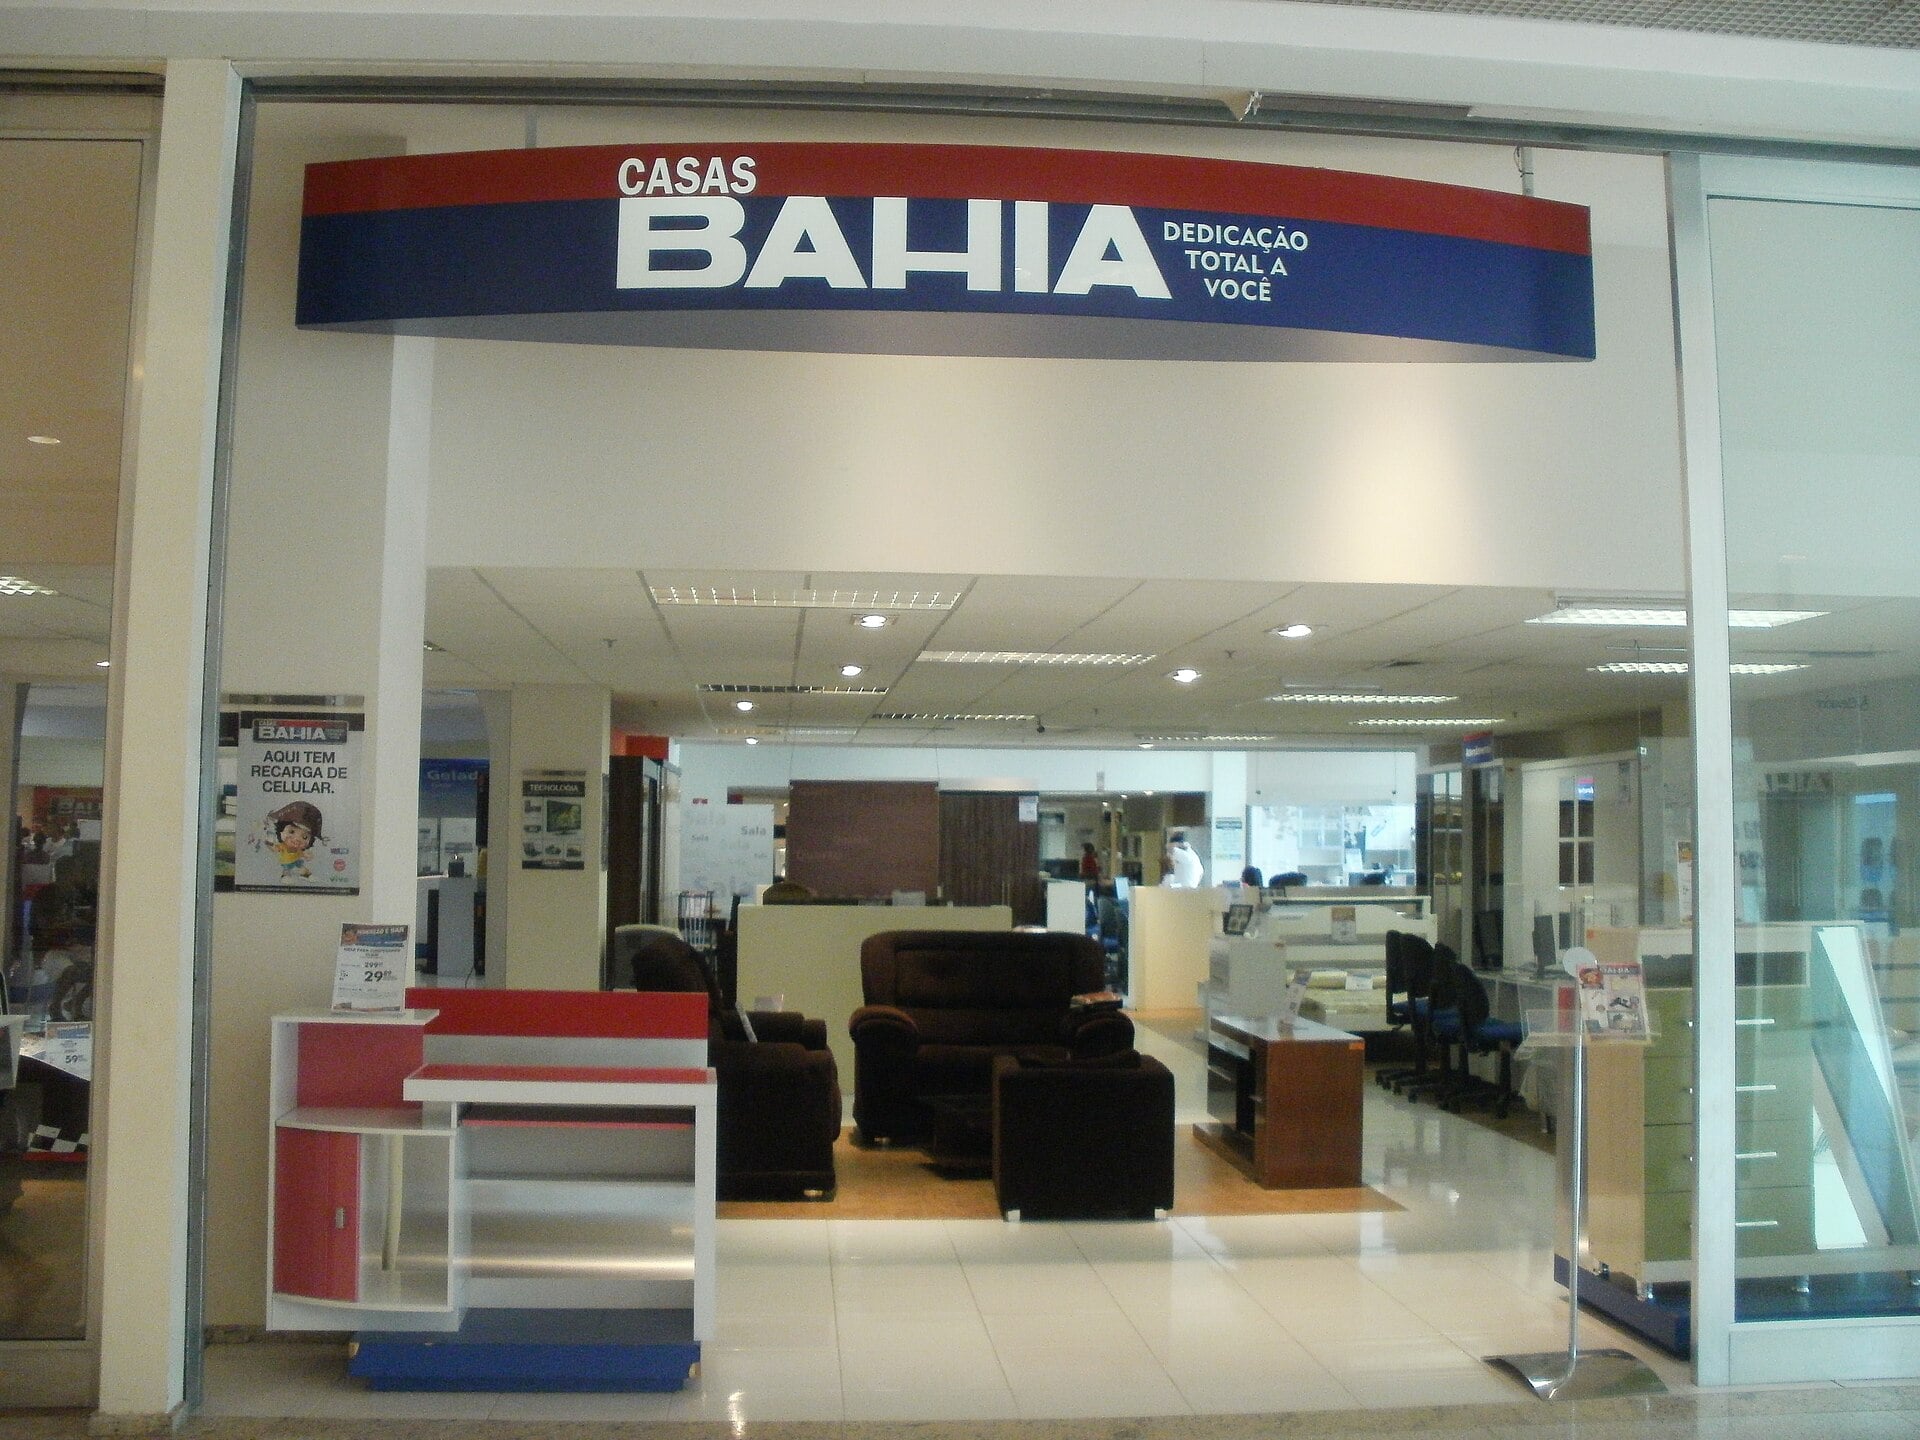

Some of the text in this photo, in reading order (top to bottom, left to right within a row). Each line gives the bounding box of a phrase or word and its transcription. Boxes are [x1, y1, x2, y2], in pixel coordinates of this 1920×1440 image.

[618, 156, 757, 195] CASAS
[1163, 221, 1309, 254] DEDICAÇÃO
[616, 195, 1173, 300] BAHIA
[1184, 249, 1288, 276] TOTAL A
[1203, 276, 1272, 302] VOCÊ
[258, 725, 326, 741] BAHIA
[263, 750, 336, 764] AQUI TEM
[250, 765, 348, 780] RECARGA DE
[262, 780, 335, 794] CELULAR.
[740, 824, 768, 837] Sala
[364, 970, 383, 983] 29
